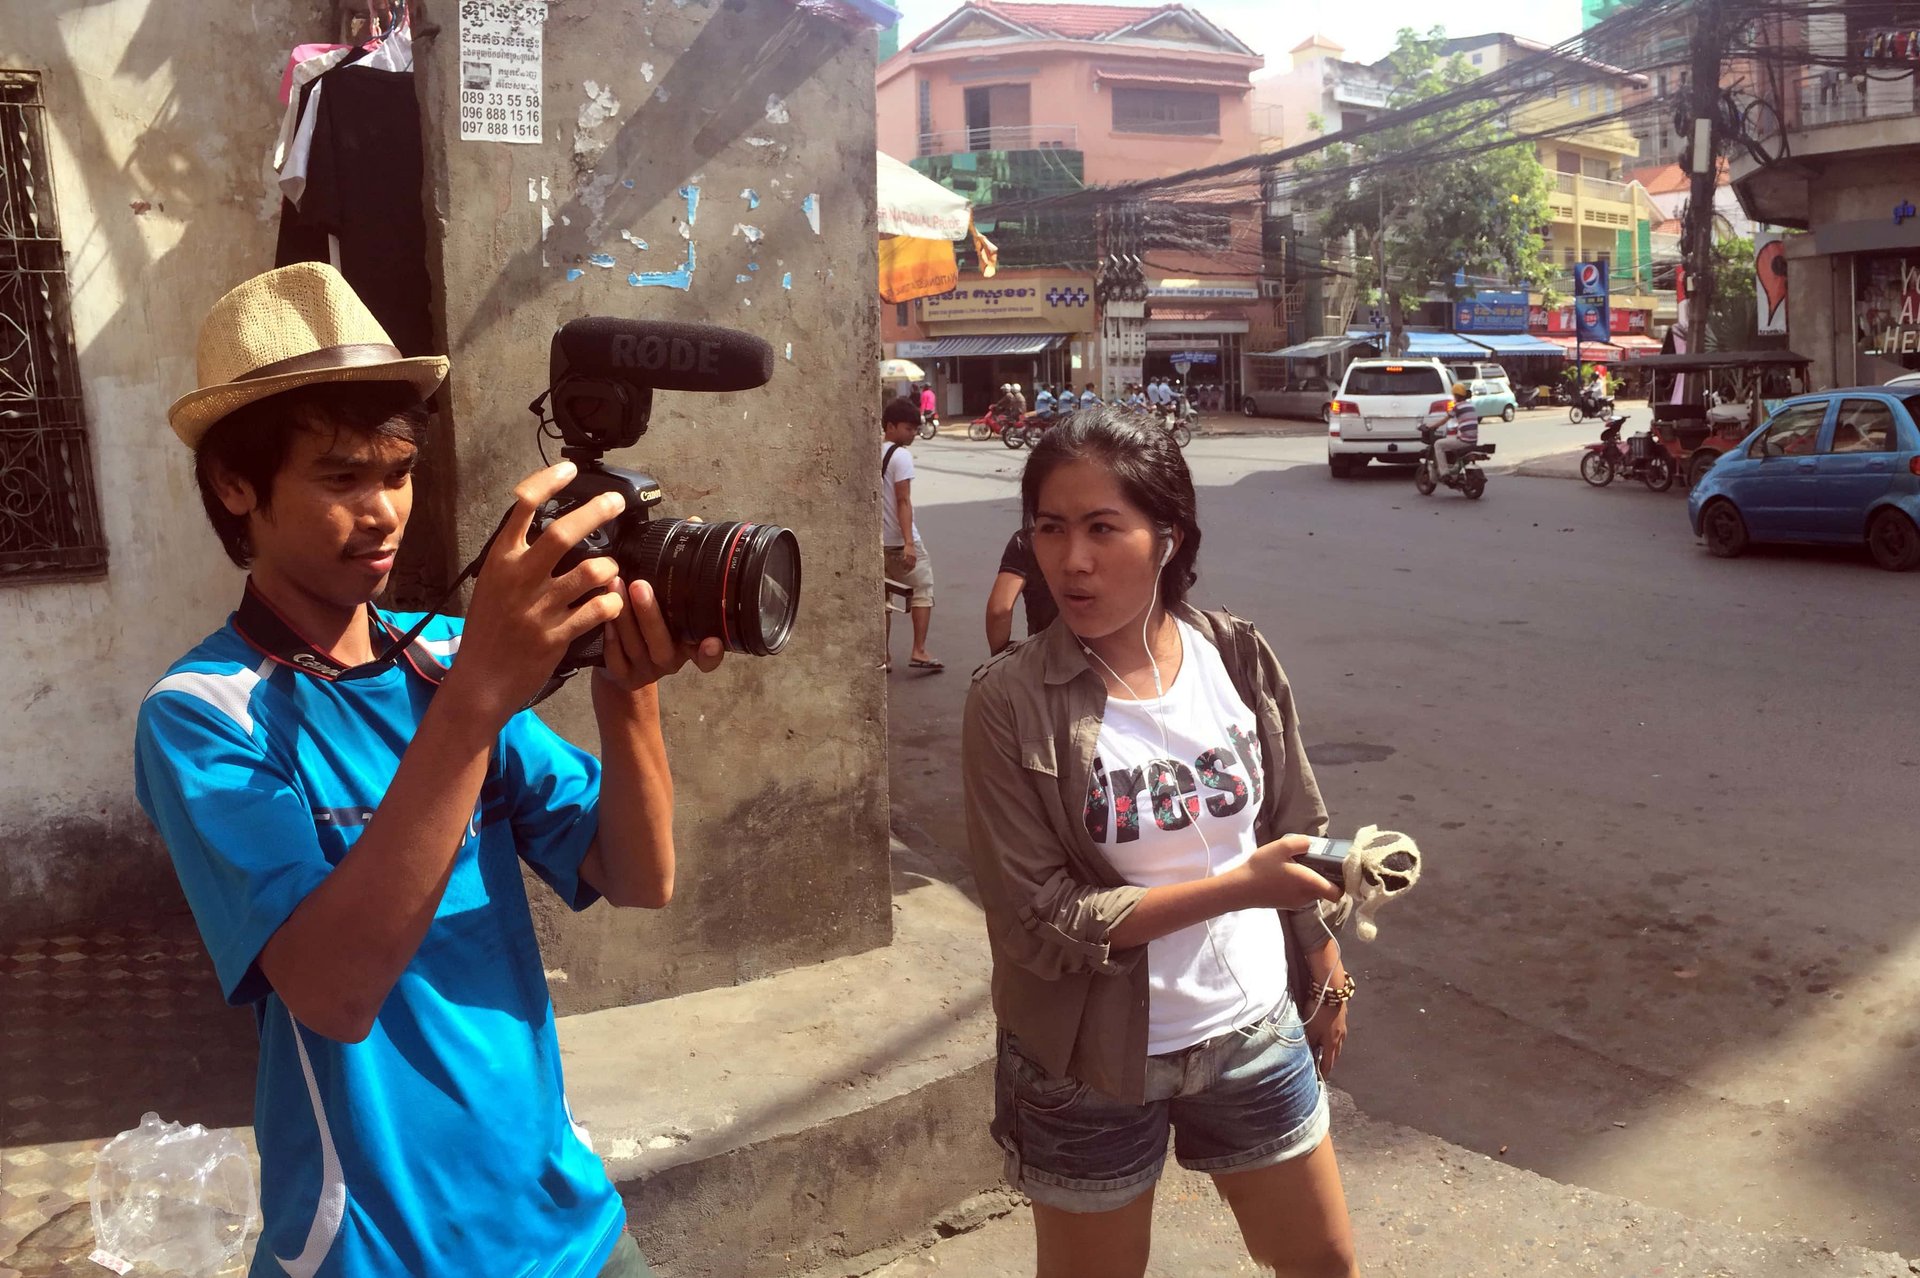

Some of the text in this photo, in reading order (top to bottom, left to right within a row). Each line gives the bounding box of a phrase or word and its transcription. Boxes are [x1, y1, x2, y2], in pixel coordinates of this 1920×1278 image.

[462, 91, 540, 108] 089 33 55 58
[462, 106, 540, 123] 096 888 15 16
[462, 121, 540, 137] 097 888 1516
[611, 334, 722, 375] RØDE
[640, 489, 662, 502] Canon
[293, 653, 341, 677] Canon
